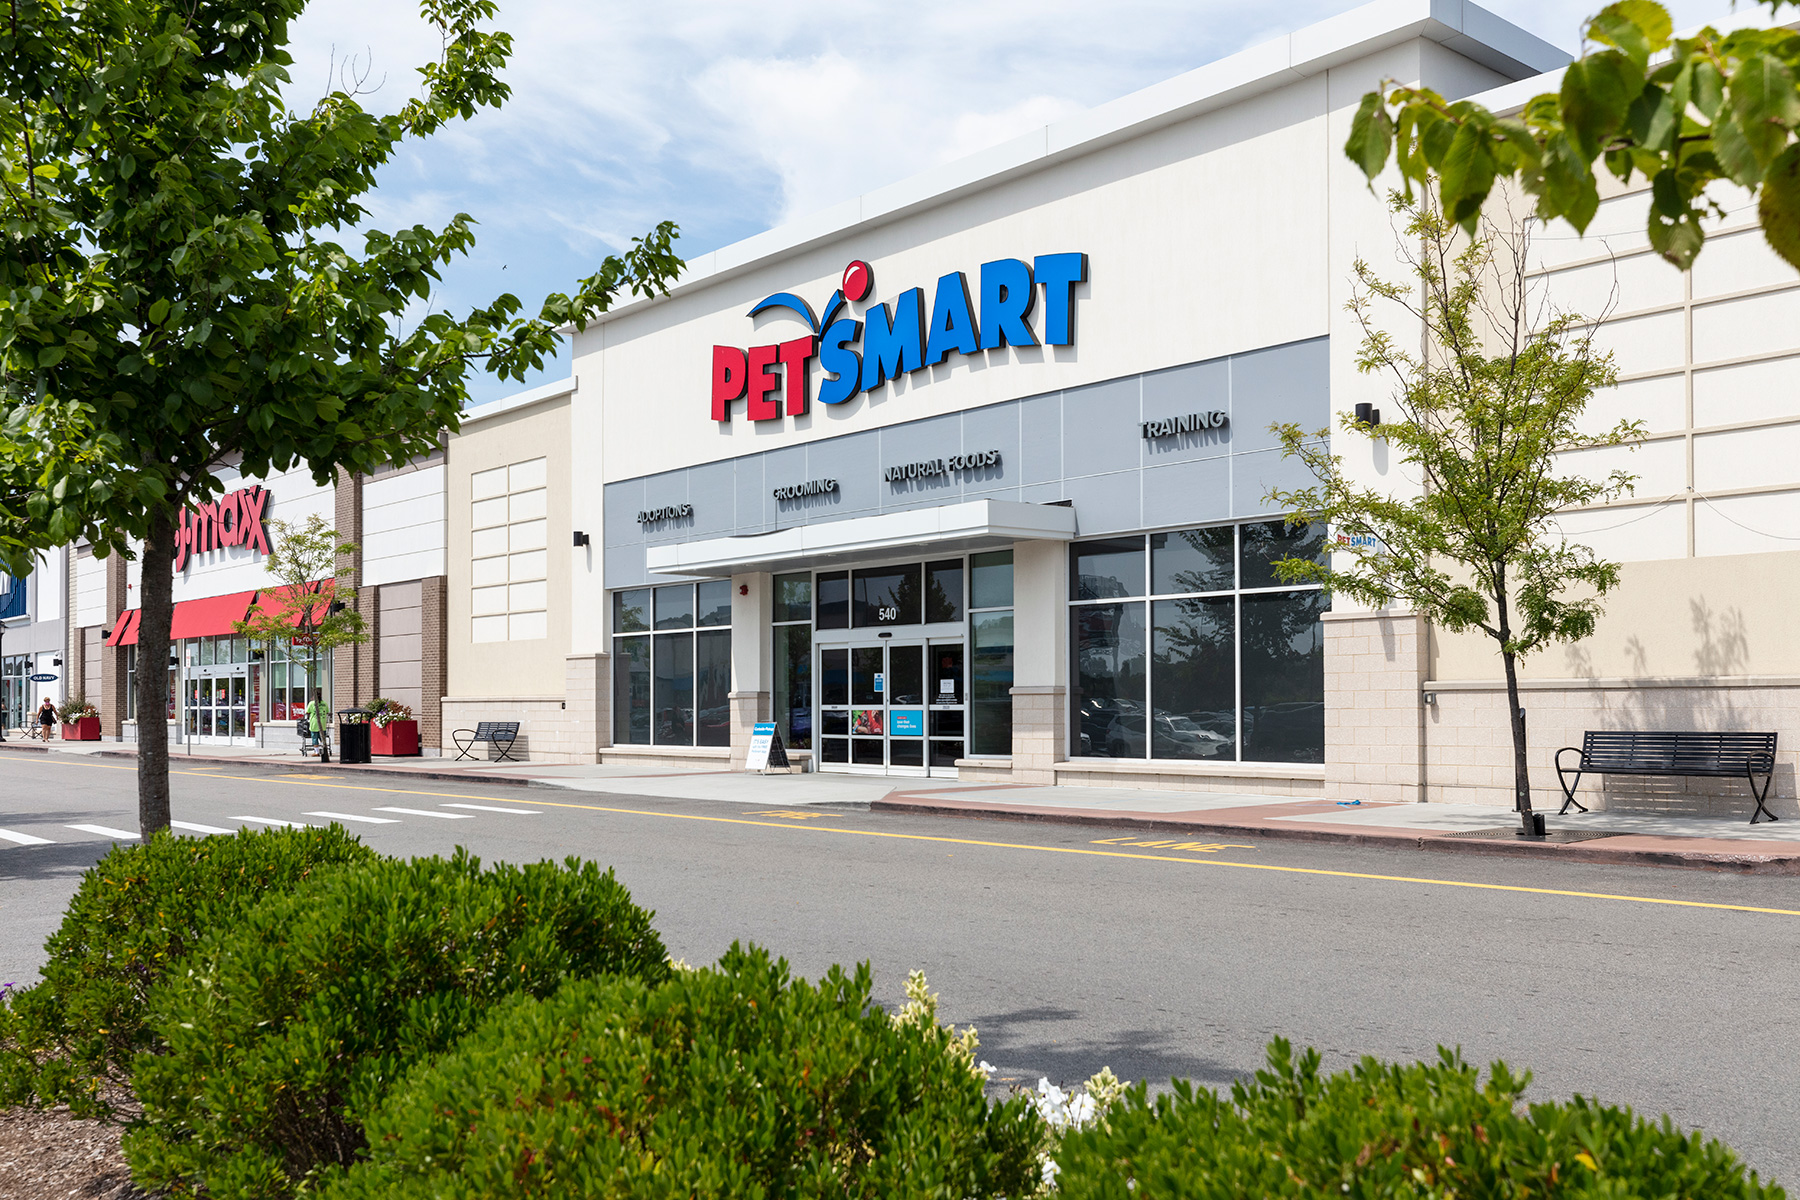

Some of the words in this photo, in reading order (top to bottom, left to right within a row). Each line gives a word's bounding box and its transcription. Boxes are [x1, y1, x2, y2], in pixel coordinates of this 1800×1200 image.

[711, 252, 1088, 422] PETSMART
[1138, 410, 1226, 439] TRAINING
[884, 459, 946, 482] NATURAL
[948, 449, 999, 472] FOODS
[773, 478, 837, 501] GROOMING
[637, 503, 692, 524] ADOPTIONS
[878, 607, 896, 621] 540
